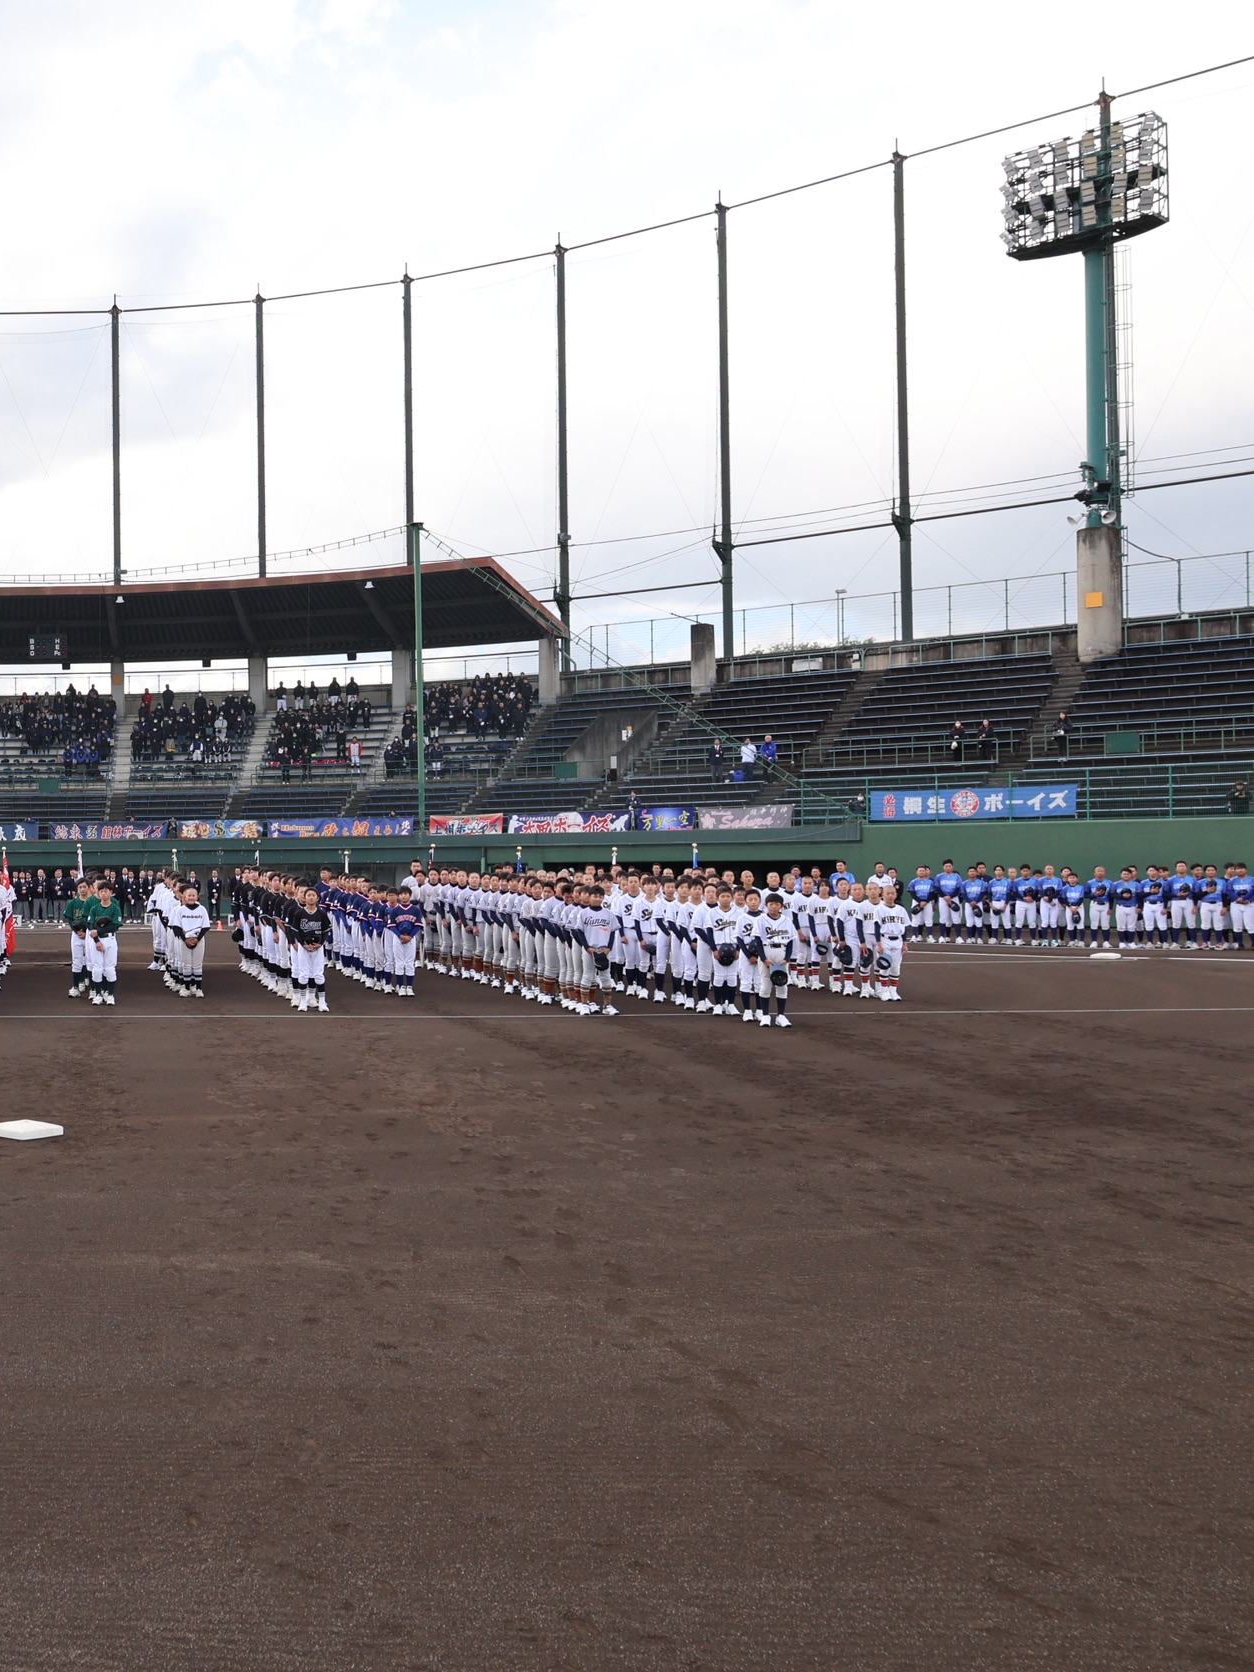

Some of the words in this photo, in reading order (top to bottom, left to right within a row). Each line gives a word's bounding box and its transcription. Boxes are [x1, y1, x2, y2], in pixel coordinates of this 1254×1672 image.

[883, 794, 896, 818] 必勝
[903, 795, 946, 815] 桐生
[984, 790, 1069, 813] ボーイズ
[521, 813, 613, 834] 太田ボーイズ
[641, 810, 691, 831] 万里一空
[719, 815, 774, 829] Sakura
[100, 825, 164, 840] 館林ボーイズ
